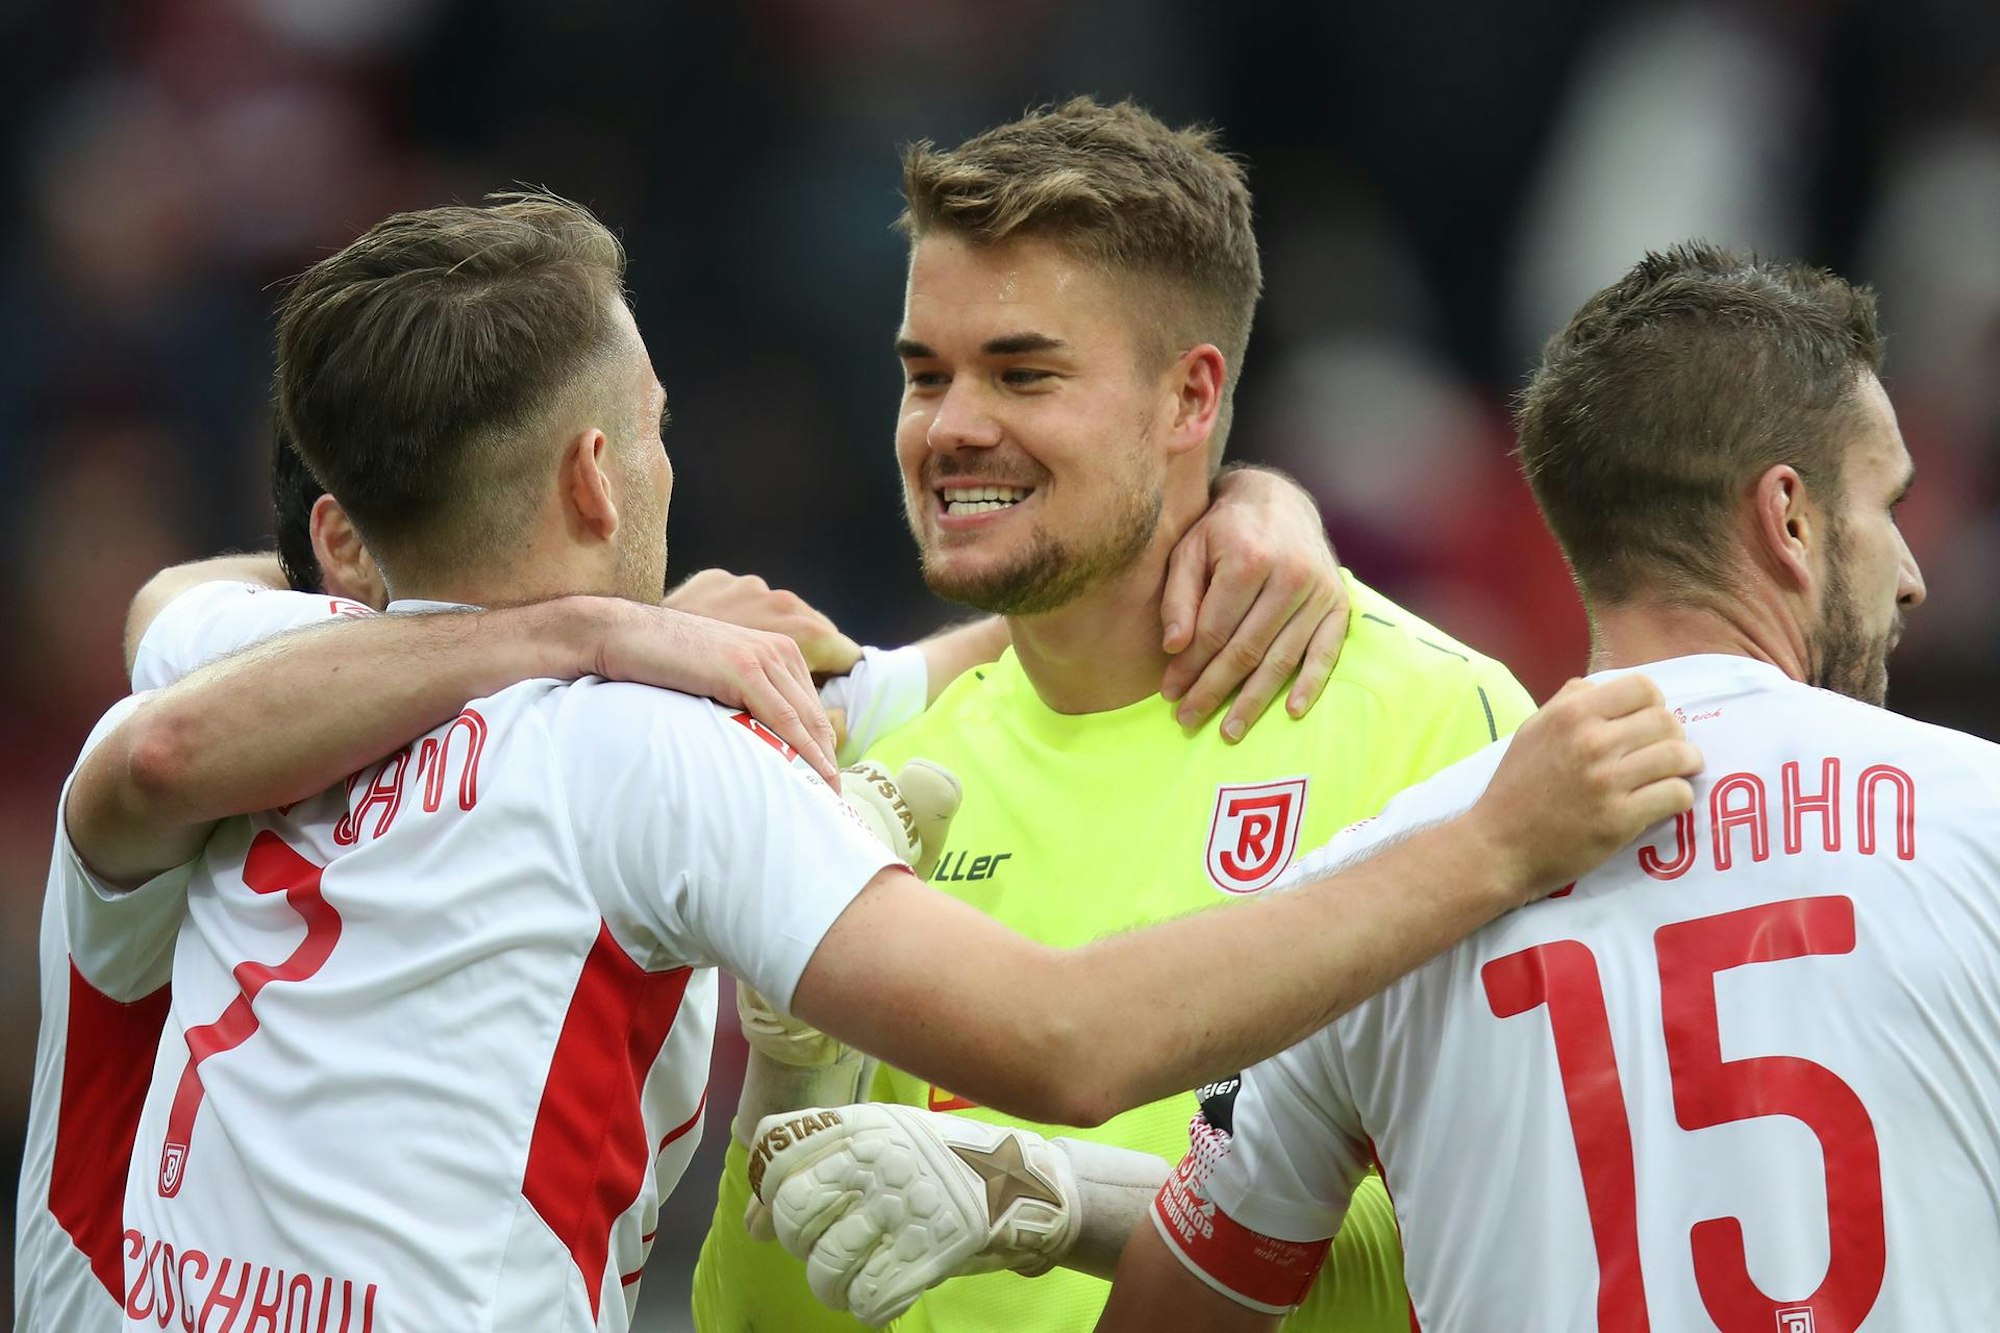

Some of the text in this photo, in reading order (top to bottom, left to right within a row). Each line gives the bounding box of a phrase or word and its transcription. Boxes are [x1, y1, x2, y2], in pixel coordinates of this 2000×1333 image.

[333, 708, 488, 846] JAN
[1638, 757, 1915, 880] JAHN
[1480, 895, 1887, 1333] 15
